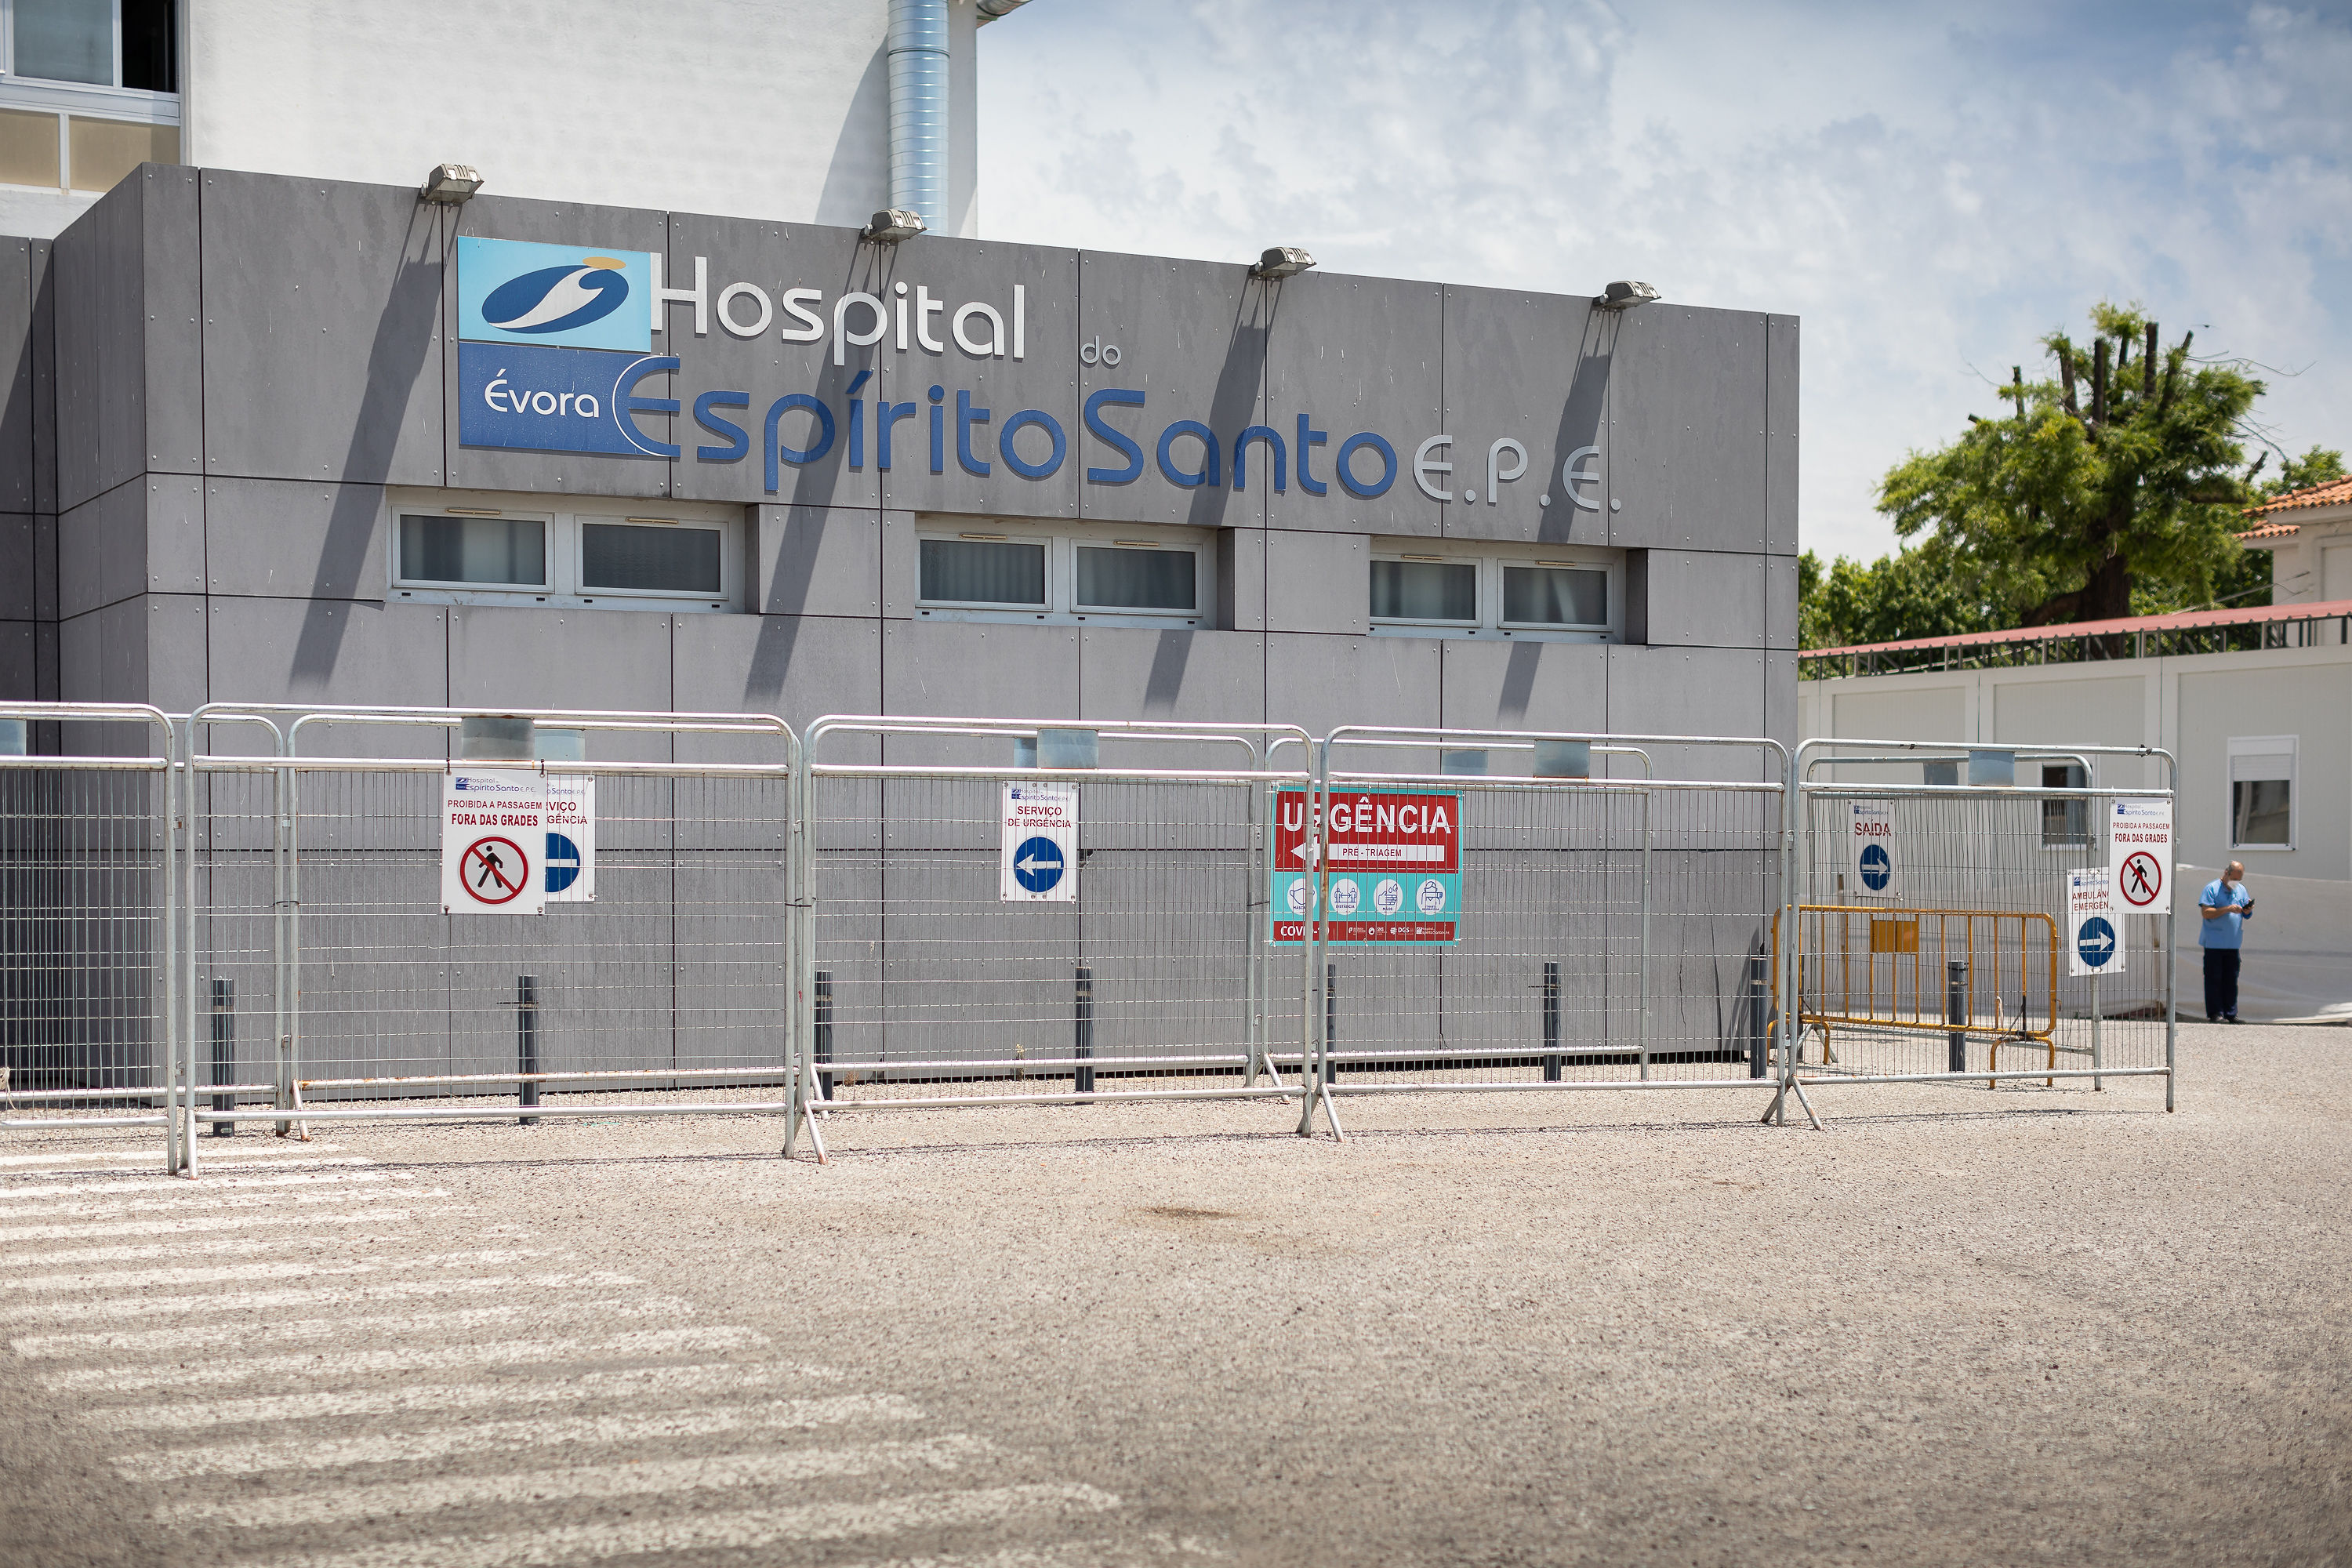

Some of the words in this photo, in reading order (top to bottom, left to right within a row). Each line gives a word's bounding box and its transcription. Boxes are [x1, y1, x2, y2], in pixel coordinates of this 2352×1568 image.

[651, 252, 1025, 366] Hospital
[1080, 335, 1122, 365] do
[484, 368, 600, 418] Évora
[613, 357, 1066, 492] Espírito
[1083, 387, 1398, 497] Santo
[448, 800, 488, 808] PROIBIDA
[546, 801, 576, 813] VIÇO
[1018, 805, 1062, 817] SERVIÇO
[452, 813, 477, 825] FORA
[480, 814, 498, 826] DAS
[501, 815, 539, 826] GRADES
[1007, 818, 1020, 826] DE
[1023, 817, 1072, 828] URGÊNCIA
[1855, 818, 1891, 837] SAÍDA
[2114, 833, 2131, 843] FORA
[2132, 833, 2143, 843] DAS
[2144, 833, 2168, 843] GRADES
[1342, 846, 1359, 856] PRÉ
[1365, 848, 1402, 857] TRIAGEM
[2072, 888, 2109, 900] AMBULÂN
